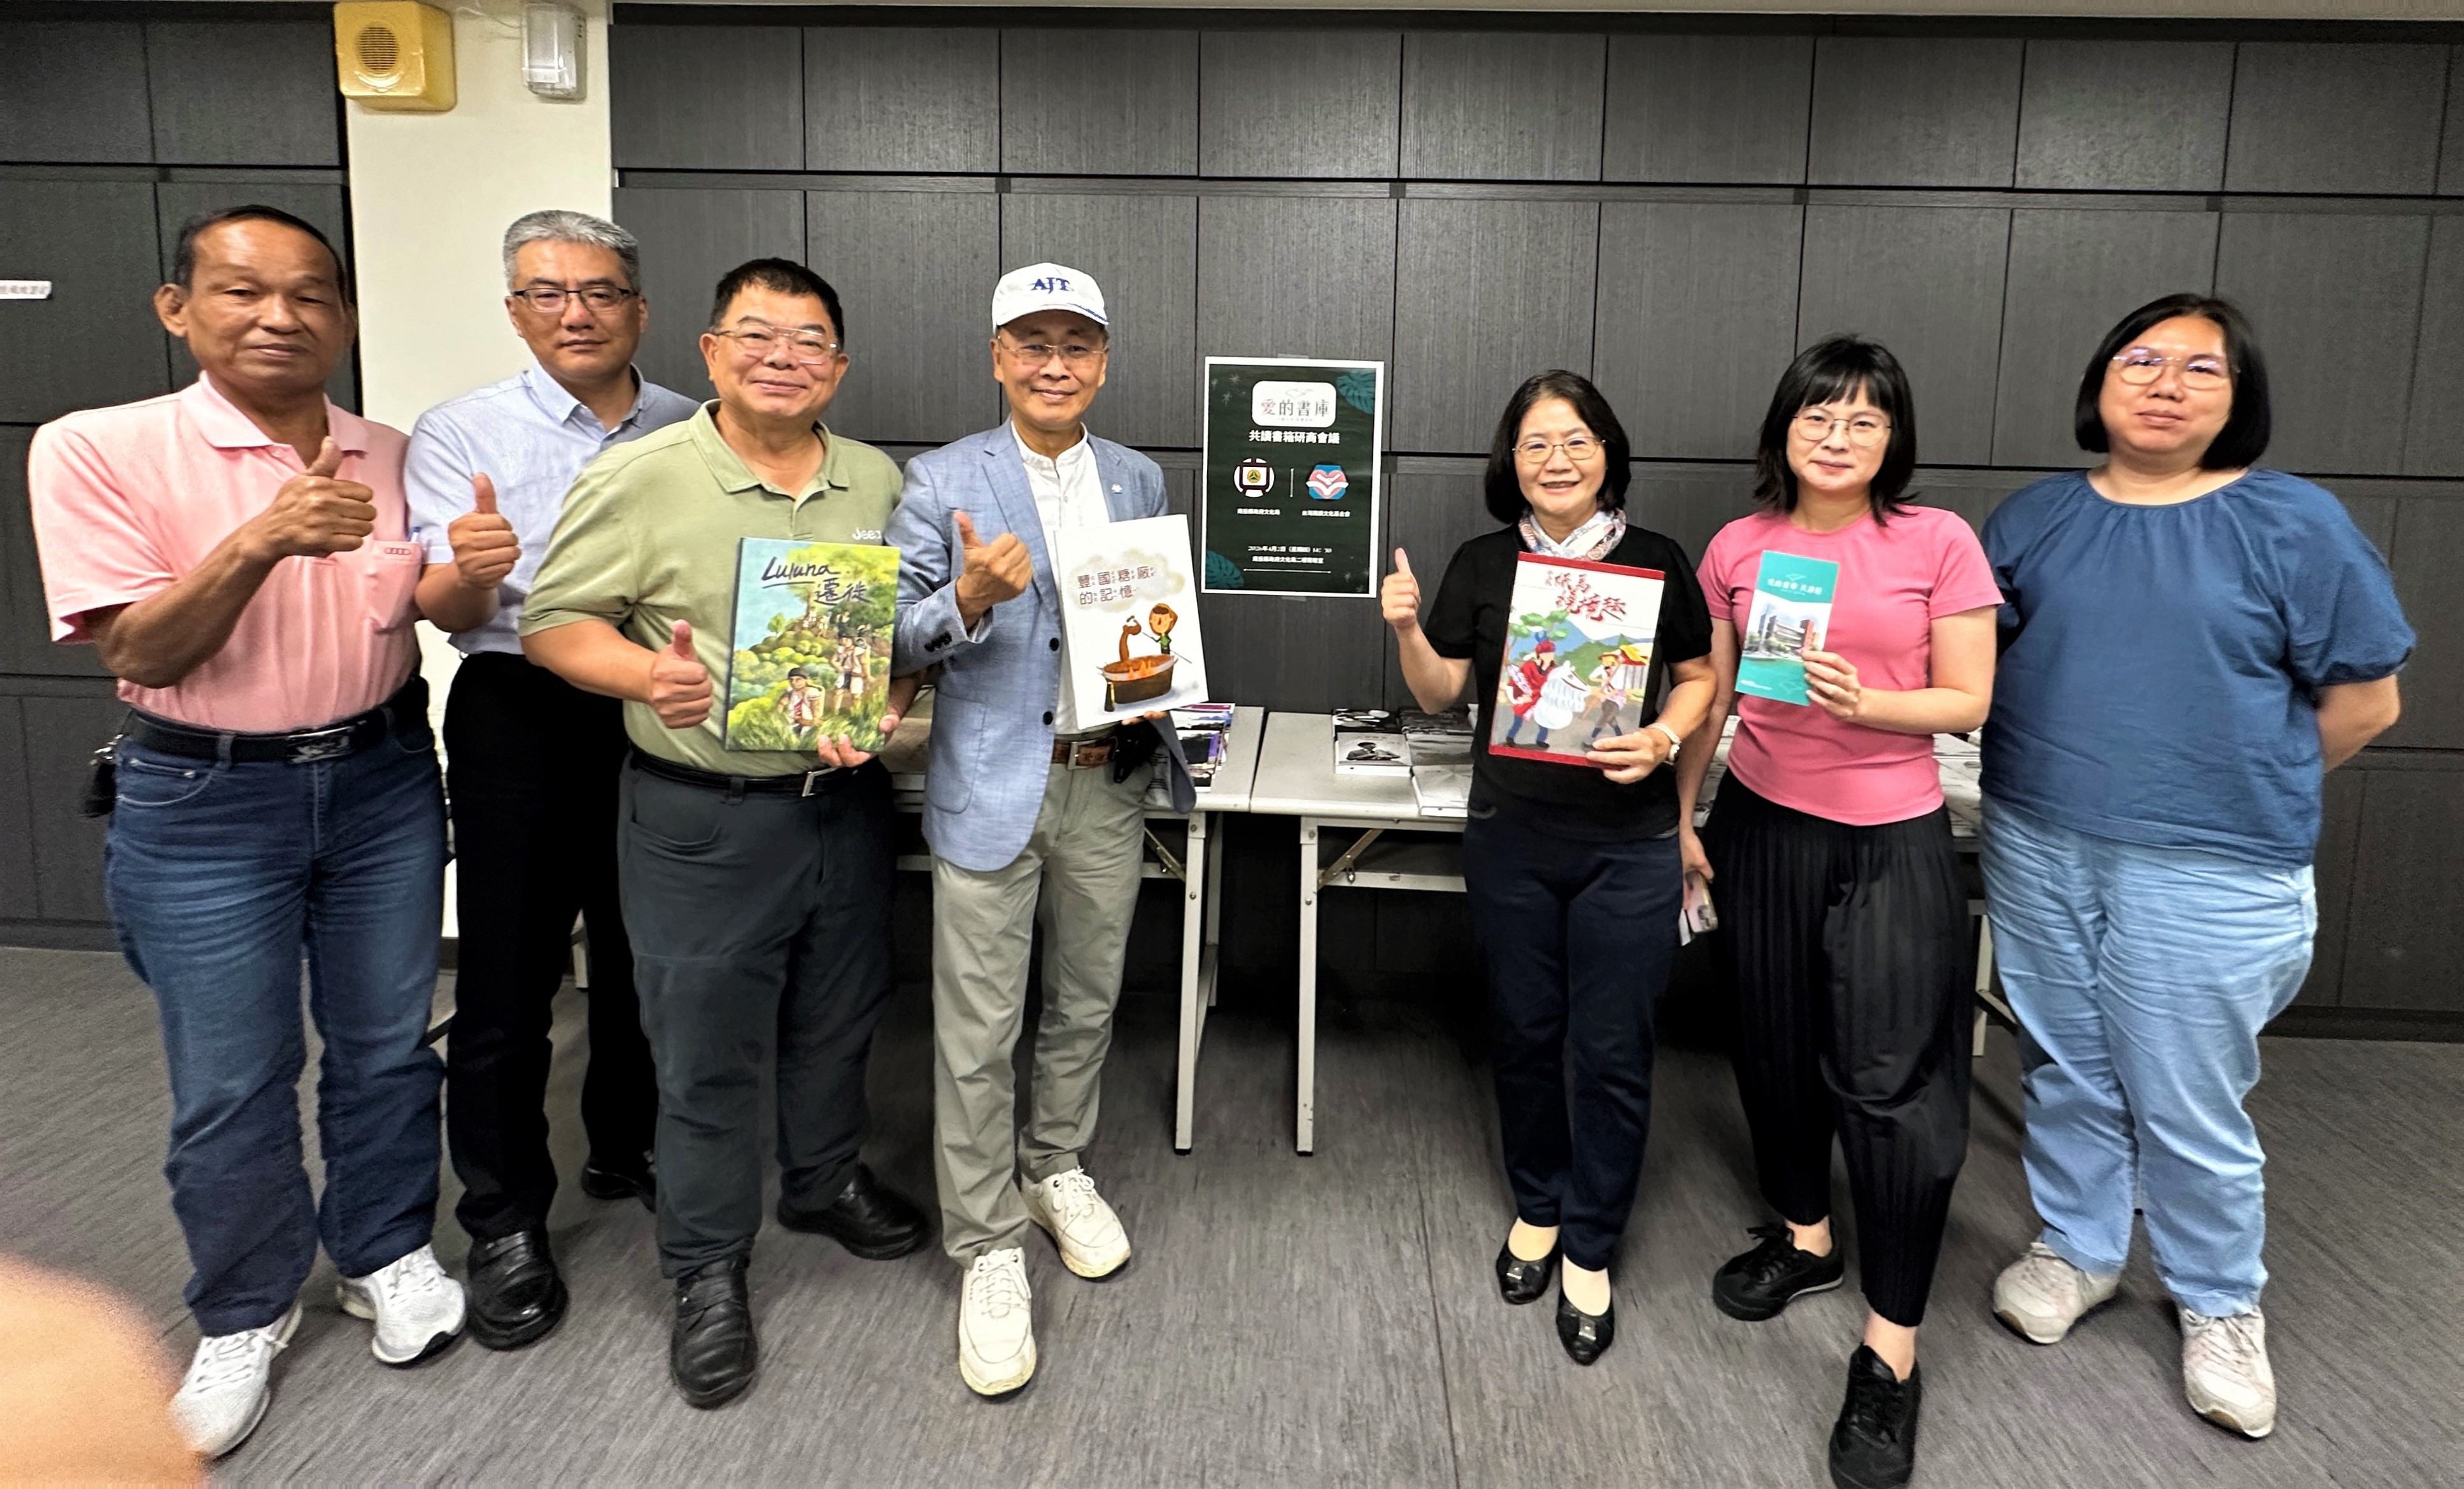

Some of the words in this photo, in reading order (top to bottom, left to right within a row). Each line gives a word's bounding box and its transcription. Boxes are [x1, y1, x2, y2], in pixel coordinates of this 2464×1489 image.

[1261, 399, 1329, 417] 愛的書庫
[761, 556, 841, 580] Luluna
[814, 577, 875, 606] 遷徙
[1080, 585, 1133, 604] 的記憶
